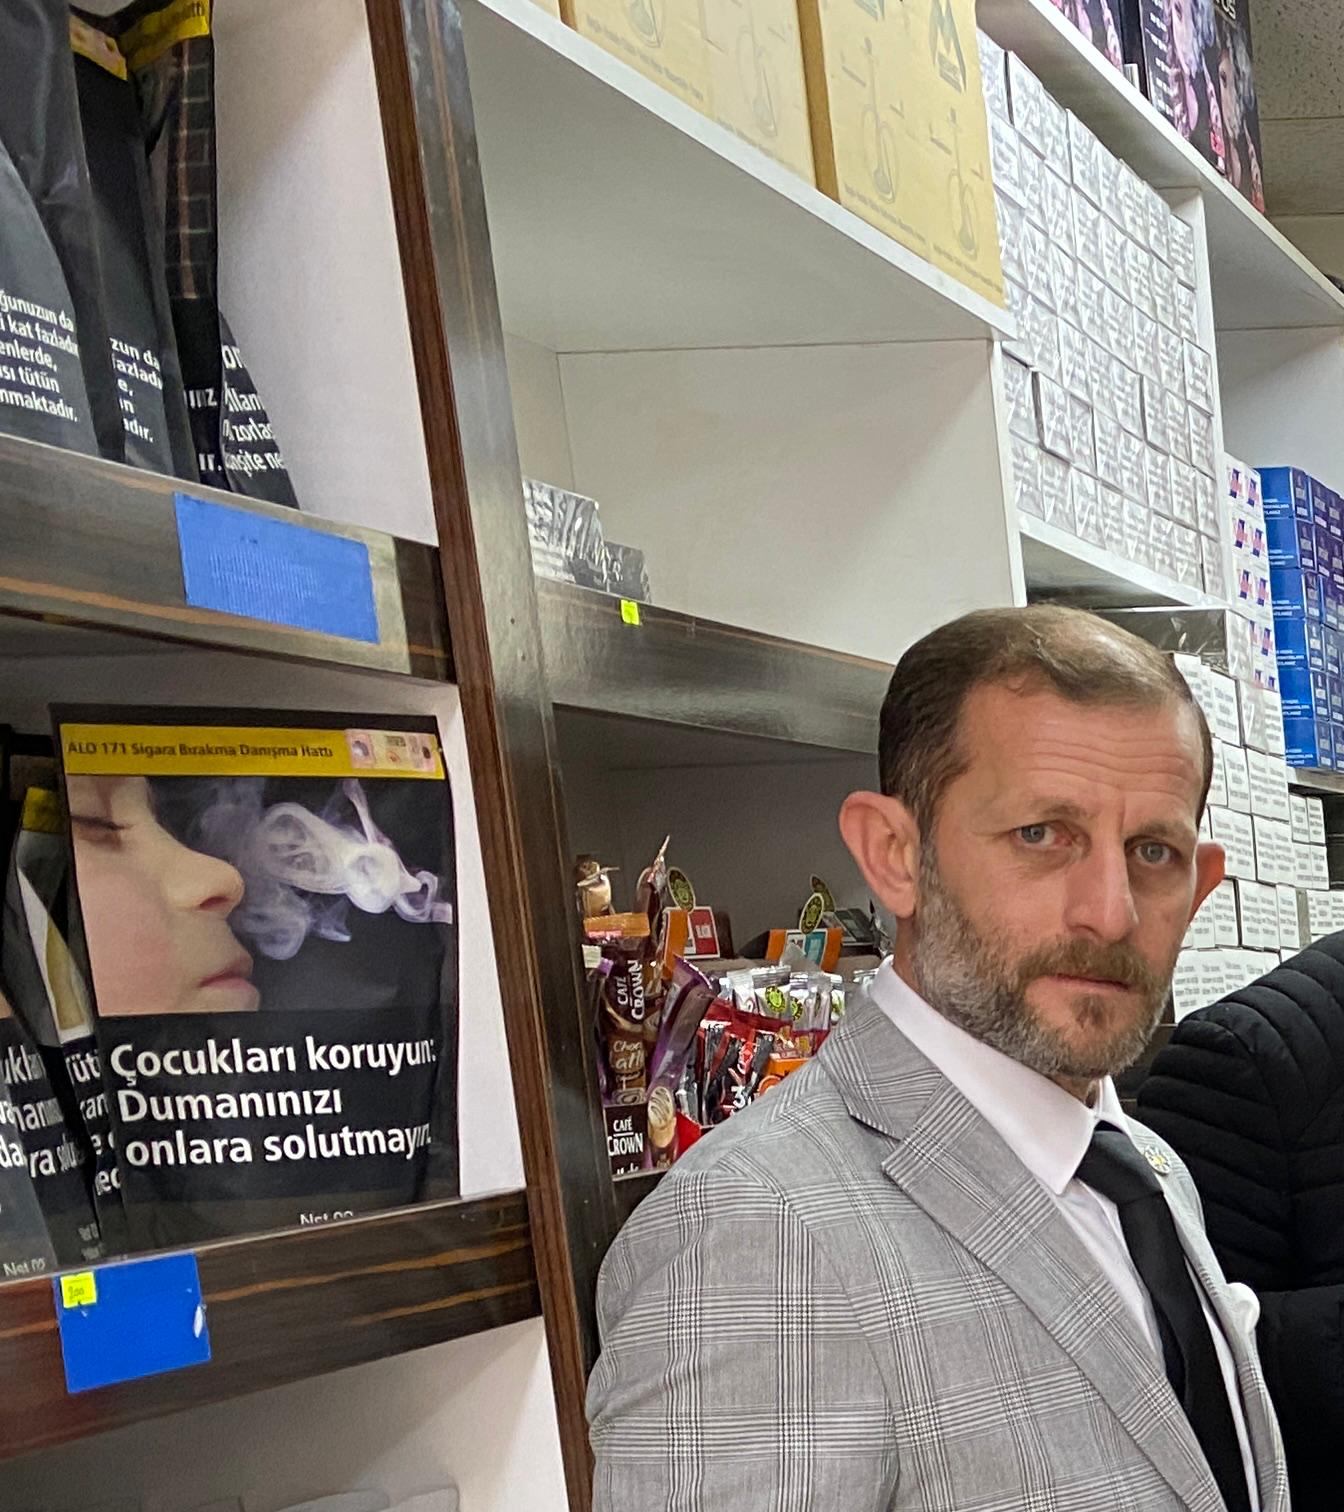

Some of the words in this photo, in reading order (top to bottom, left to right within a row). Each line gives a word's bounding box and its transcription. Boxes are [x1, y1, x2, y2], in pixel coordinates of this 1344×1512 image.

[9, 316, 33, 338] kat
[59, 309, 73, 331] da
[19, 366, 60, 393] tütün
[68, 742, 96, 754] ALO
[101, 742, 127, 755] 171
[131, 743, 177, 758] Sigara
[179, 744, 236, 757] Bırakma
[240, 744, 298, 759] Danışma
[628, 959, 645, 1021] CROWN
[110, 1039, 297, 1087] Çocukları
[306, 1035, 437, 1076] koruyun:
[117, 1088, 343, 1123] Dumanınızı
[125, 1132, 253, 1168] onlara
[264, 1121, 432, 1162] solutmayın.
[607, 1133, 644, 1157] CROWN
